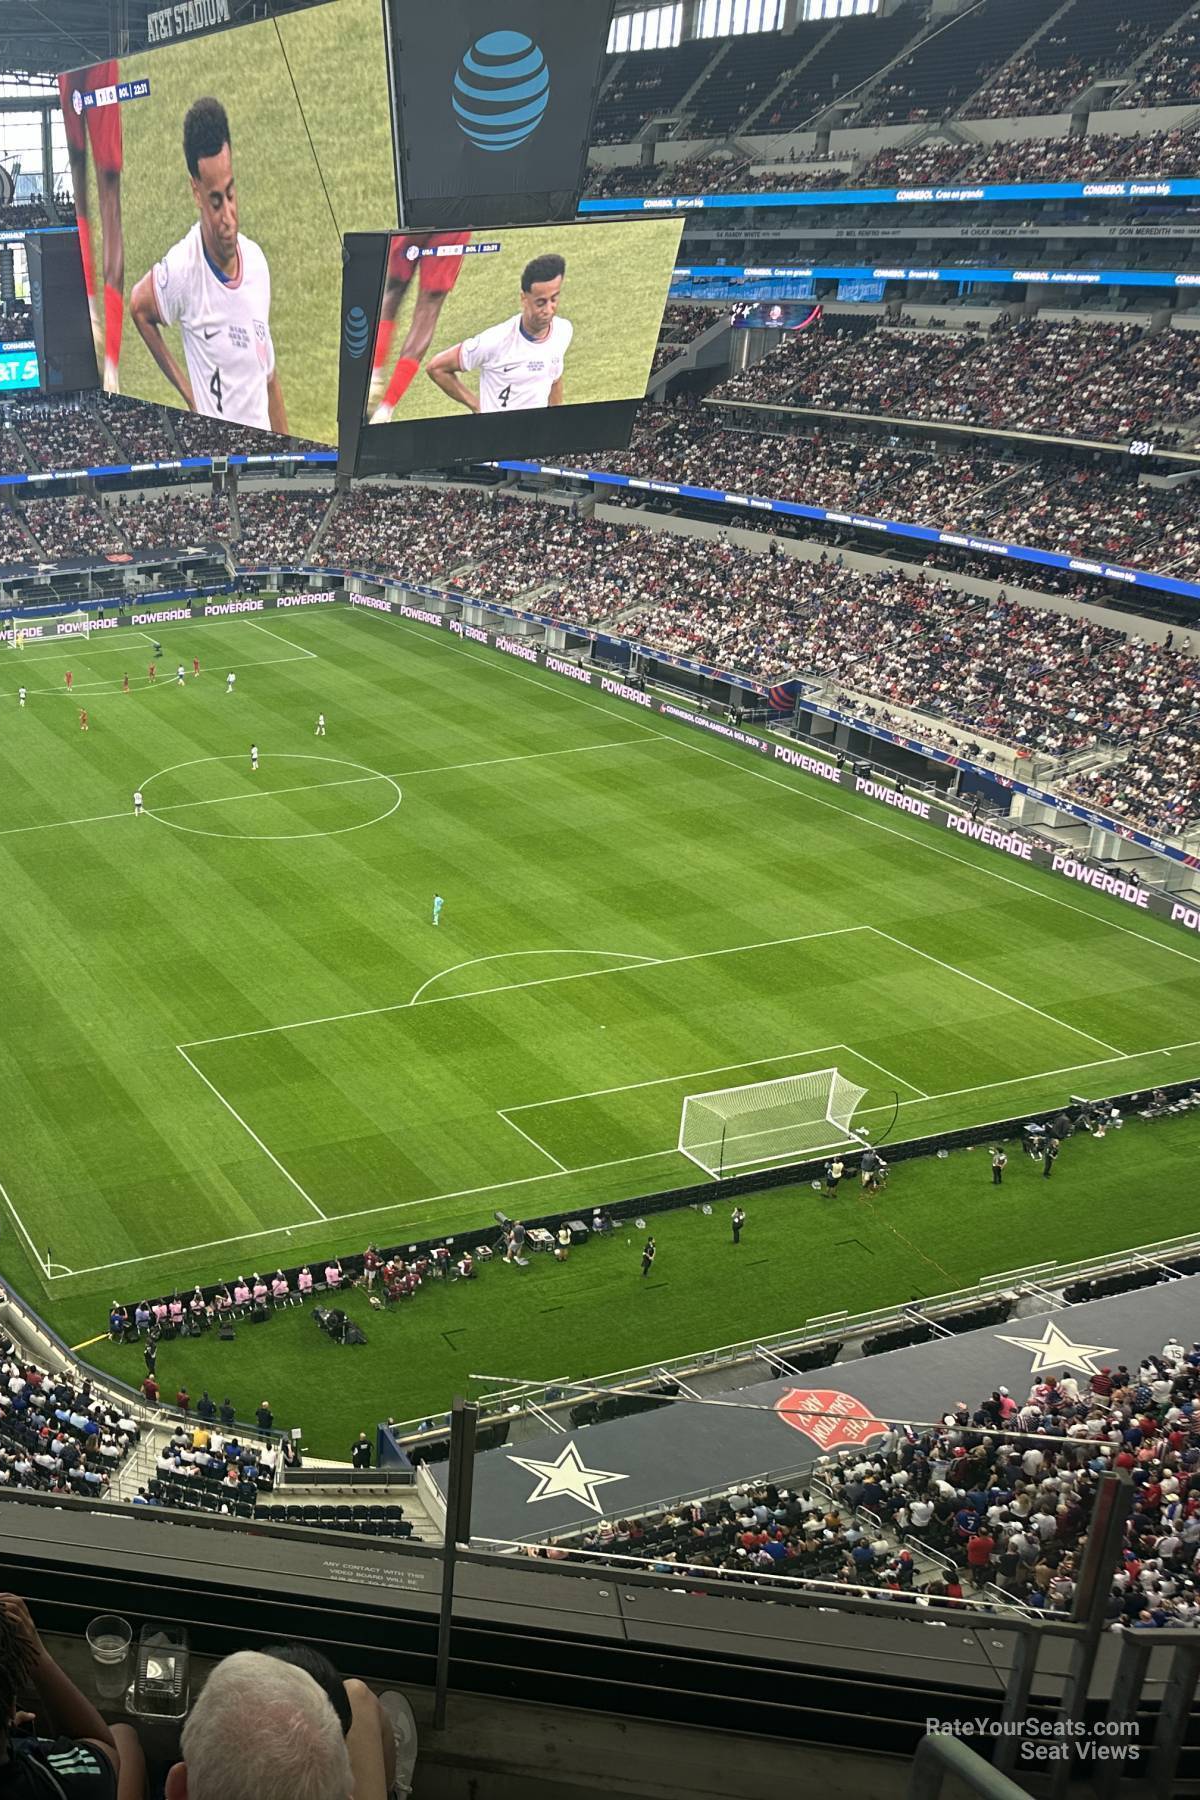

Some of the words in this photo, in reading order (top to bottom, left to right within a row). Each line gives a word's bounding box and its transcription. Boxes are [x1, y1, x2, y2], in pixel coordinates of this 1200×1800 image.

[148, 8, 173, 42] AT&T
[174, 0, 230, 35] STADIUM
[84, 95, 93, 106] USA
[1119, 228, 1133, 236] DON
[1136, 227, 1170, 236] MEREDITH
[210, 366, 223, 413] 4
[498, 384, 511, 408] 4
[204, 599, 264, 617] POWERADE
[276, 591, 336, 608] POWERADE
[57, 617, 118, 635] POWERADE
[131, 608, 192, 626] POWERADE
[400, 605, 442, 627] POWERADE
[495, 635, 537, 663] POWERADE
[546, 655, 592, 684] POWERADE
[601, 677, 652, 707] POWERADE
[774, 744, 841, 784] POWERADE
[855, 776, 930, 819] POWERADE
[947, 812, 1033, 861] POWERADE
[1052, 854, 1149, 909] POWERADE
[842, 1418, 869, 1440] THE
[329, 1568, 354, 1576] VIDEO
[356, 1572, 384, 1580] BOARD
[342, 1563, 381, 1573] CONTACT
[383, 1569, 404, 1577] WITH
